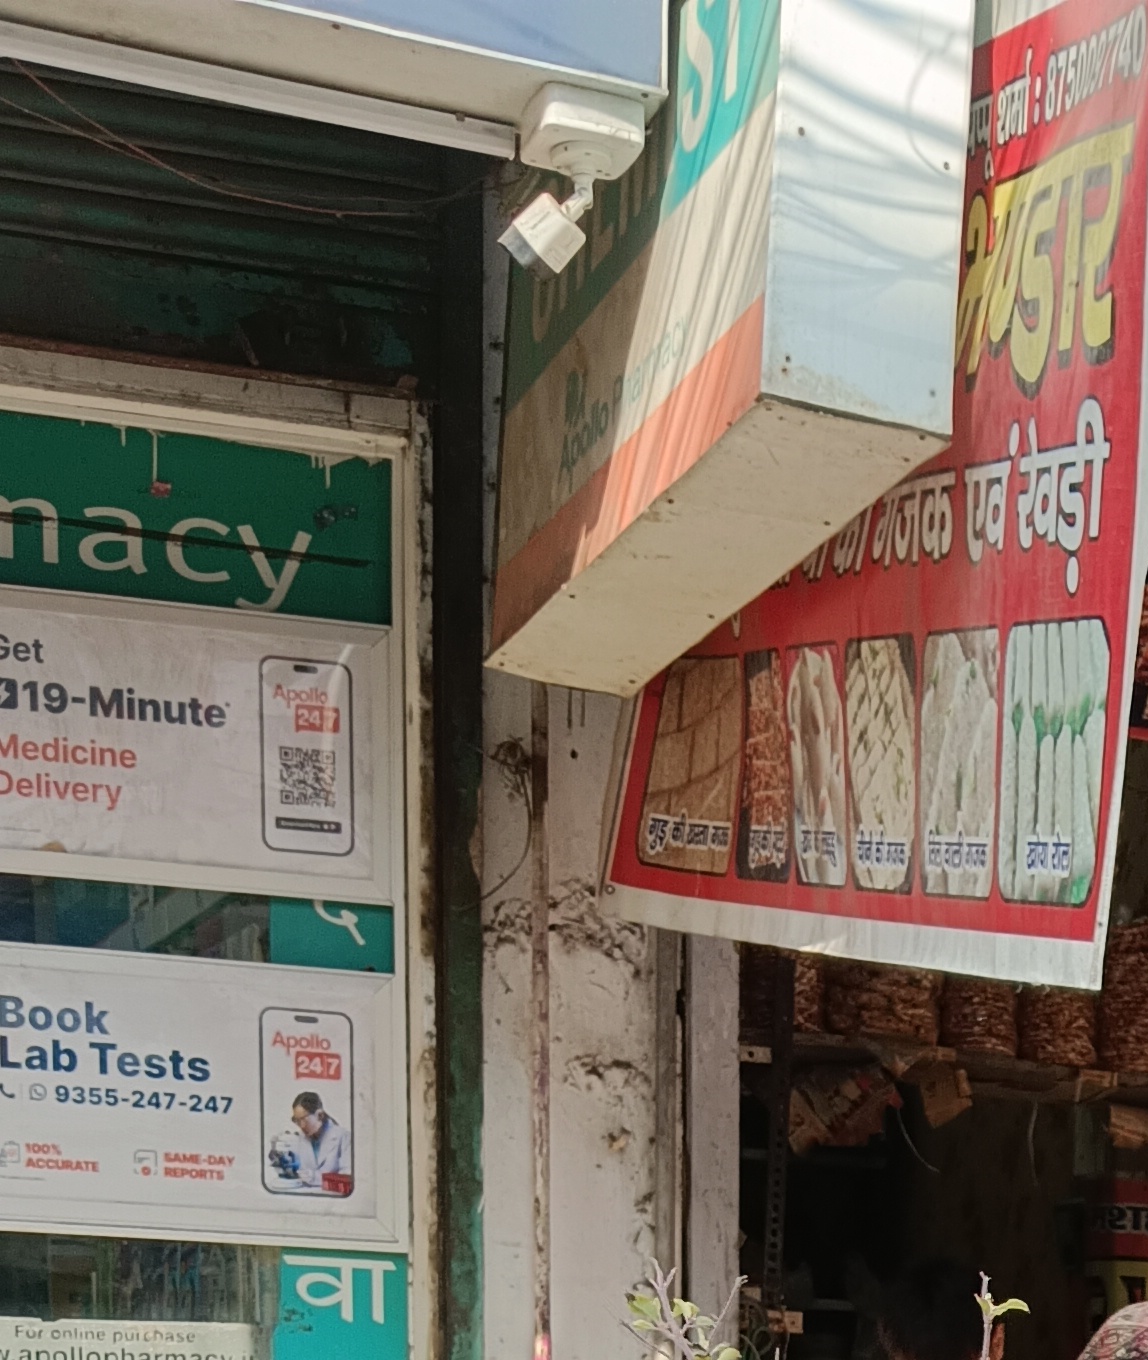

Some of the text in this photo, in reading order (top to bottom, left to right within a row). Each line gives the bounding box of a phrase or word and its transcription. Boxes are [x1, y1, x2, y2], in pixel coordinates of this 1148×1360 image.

[1045, 5, 1147, 122] 8750097740
[965, 423, 1021, 563] एवं
[273, 683, 329, 709] Apollo
[0, 733, 137, 769] Medicine
[0, 769, 122, 811] Delivery
[0, 995, 110, 1035] Book
[0, 1035, 211, 1082] Lab Tests
[271, 1031, 332, 1057] Apollo
[55, 1085, 233, 1114] 9355-247-247
[25, 1157, 99, 1173] ACCURATE
[163, 1152, 235, 1167] SAME-DAY
[163, 1166, 225, 1181] REPORTS
[51, 1326, 106, 1341] online
[113, 1329, 196, 1344] purchase
